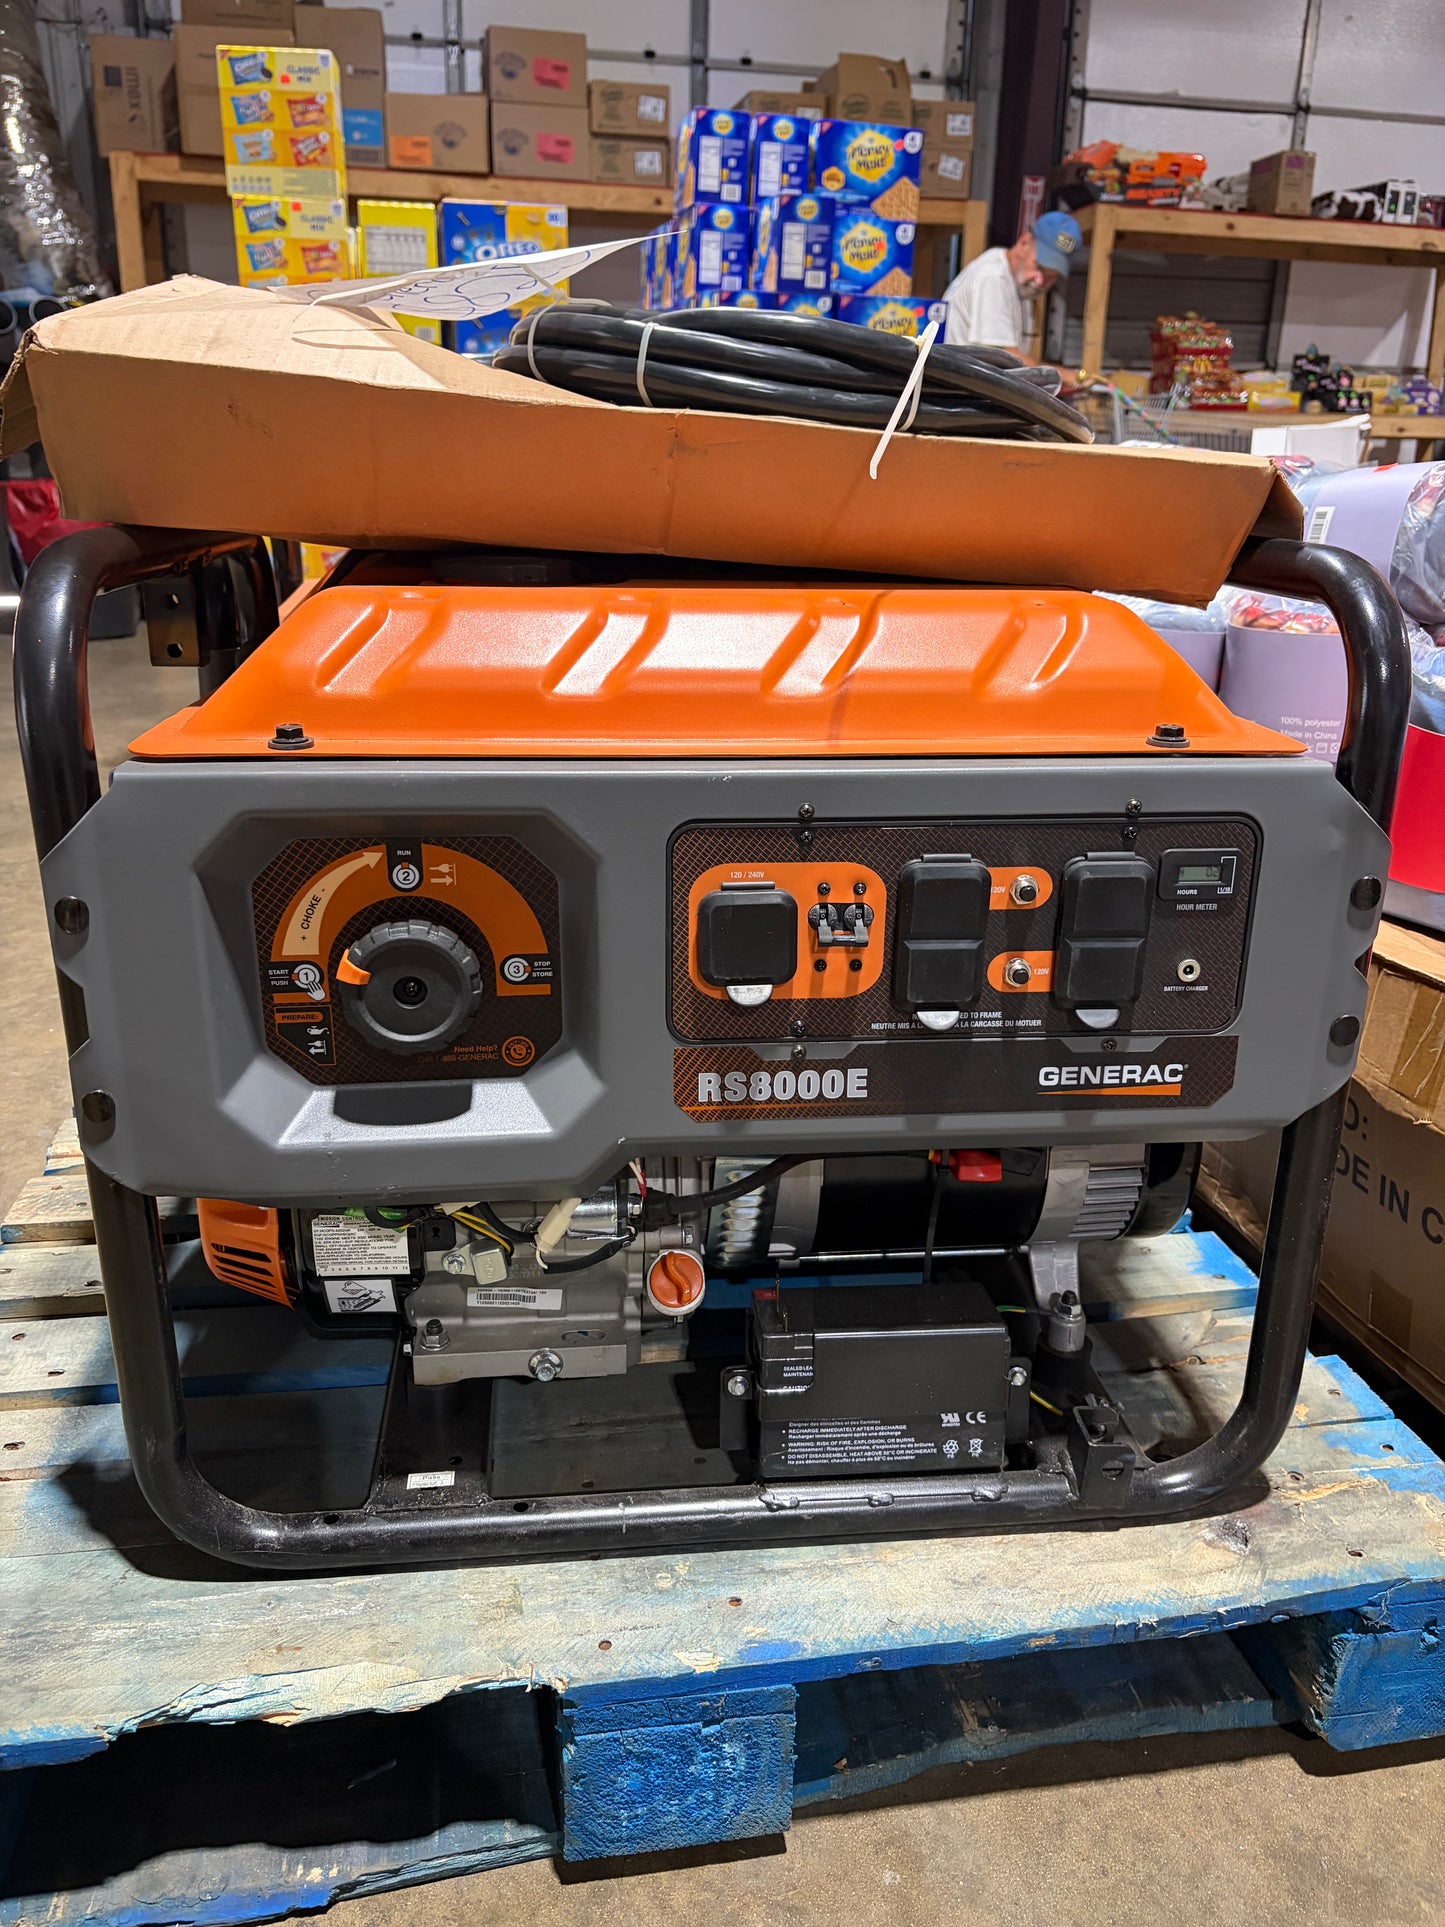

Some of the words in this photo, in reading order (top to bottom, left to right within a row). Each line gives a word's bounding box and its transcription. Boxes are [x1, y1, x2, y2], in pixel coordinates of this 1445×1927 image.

[475, 241, 541, 261] OREO
[1281, 716, 1303, 726] 100%
[1304, 719, 1342, 728] polyester
[1304, 731, 1312, 739] in
[1313, 730, 1338, 740] China
[402, 870, 411, 882] 2
[729, 871, 742, 879] 120
[300, 894, 323, 930] CHOKE
[1176, 903, 1194, 911] HOUR
[1195, 903, 1218, 911] METER
[513, 964, 521, 974] 3
[303, 971, 310, 982] 1
[979, 1011, 1003, 1019] FRAME
[871, 1022, 896, 1030] NEUTRE
[897, 1022, 910, 1030] MIS
[960, 1020, 969, 1028] LA
[970, 1019, 1004, 1028] CARCASSE
[1004, 1019, 1014, 1027] DU
[476, 1044, 498, 1053] Help?
[1038, 1064, 1183, 1087] GENERAC
[698, 1068, 869, 1103] RS8000E
[1336, 1143, 1371, 1195] DE
[1379, 1172, 1411, 1224] IN
